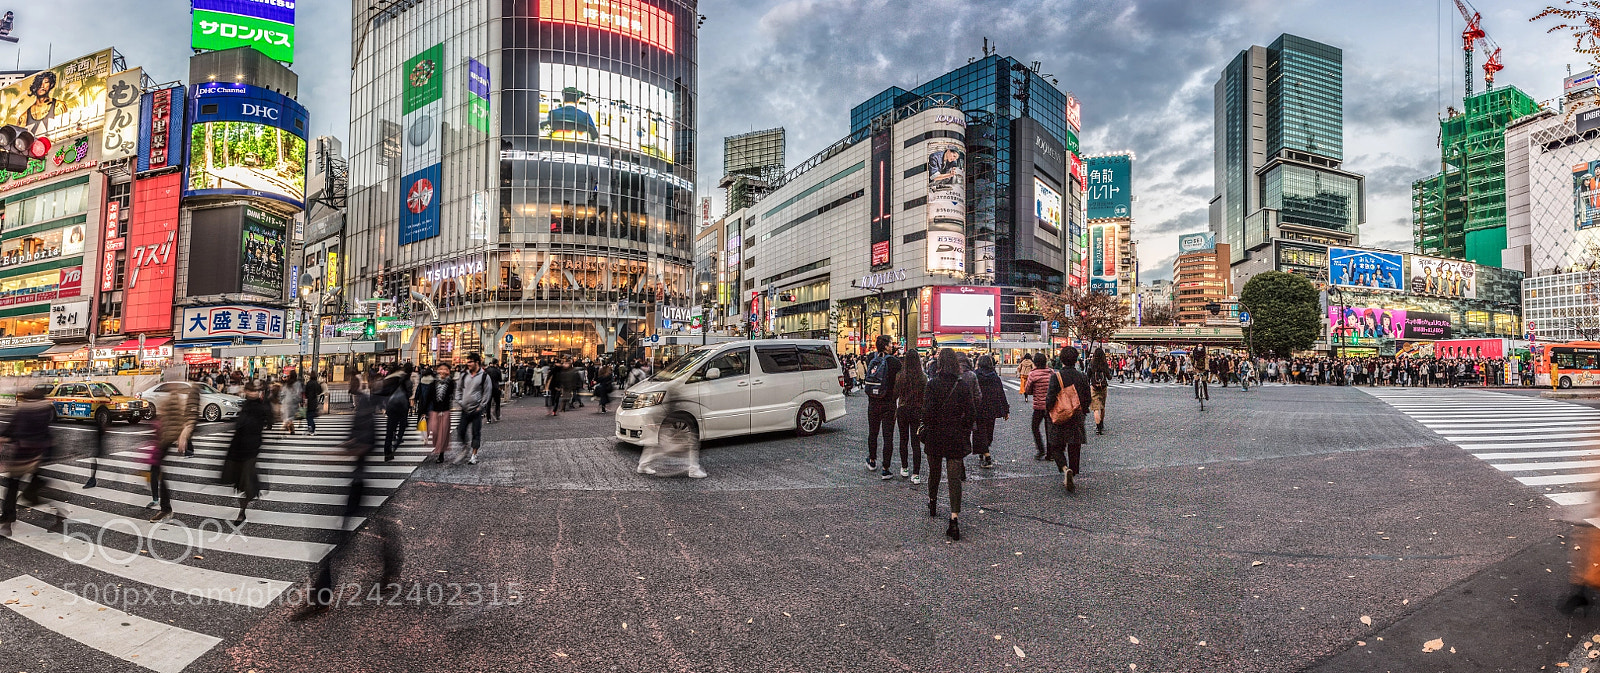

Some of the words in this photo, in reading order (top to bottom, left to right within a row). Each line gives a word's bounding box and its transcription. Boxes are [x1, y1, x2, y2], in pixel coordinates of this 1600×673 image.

[199, 20, 291, 48] サロンパス
[108, 79, 139, 155] もんじゃ
[241, 104, 279, 120] DHC
[1089, 167, 1114, 184] 角散
[1087, 184, 1120, 201] イレクト
[3, 248, 59, 265] Euphoria
[129, 230, 176, 289] クスリ
[61, 269, 81, 286] JTB
[426, 260, 484, 282] TSUTAYA
[188, 310, 281, 333] 大盛堂書店
